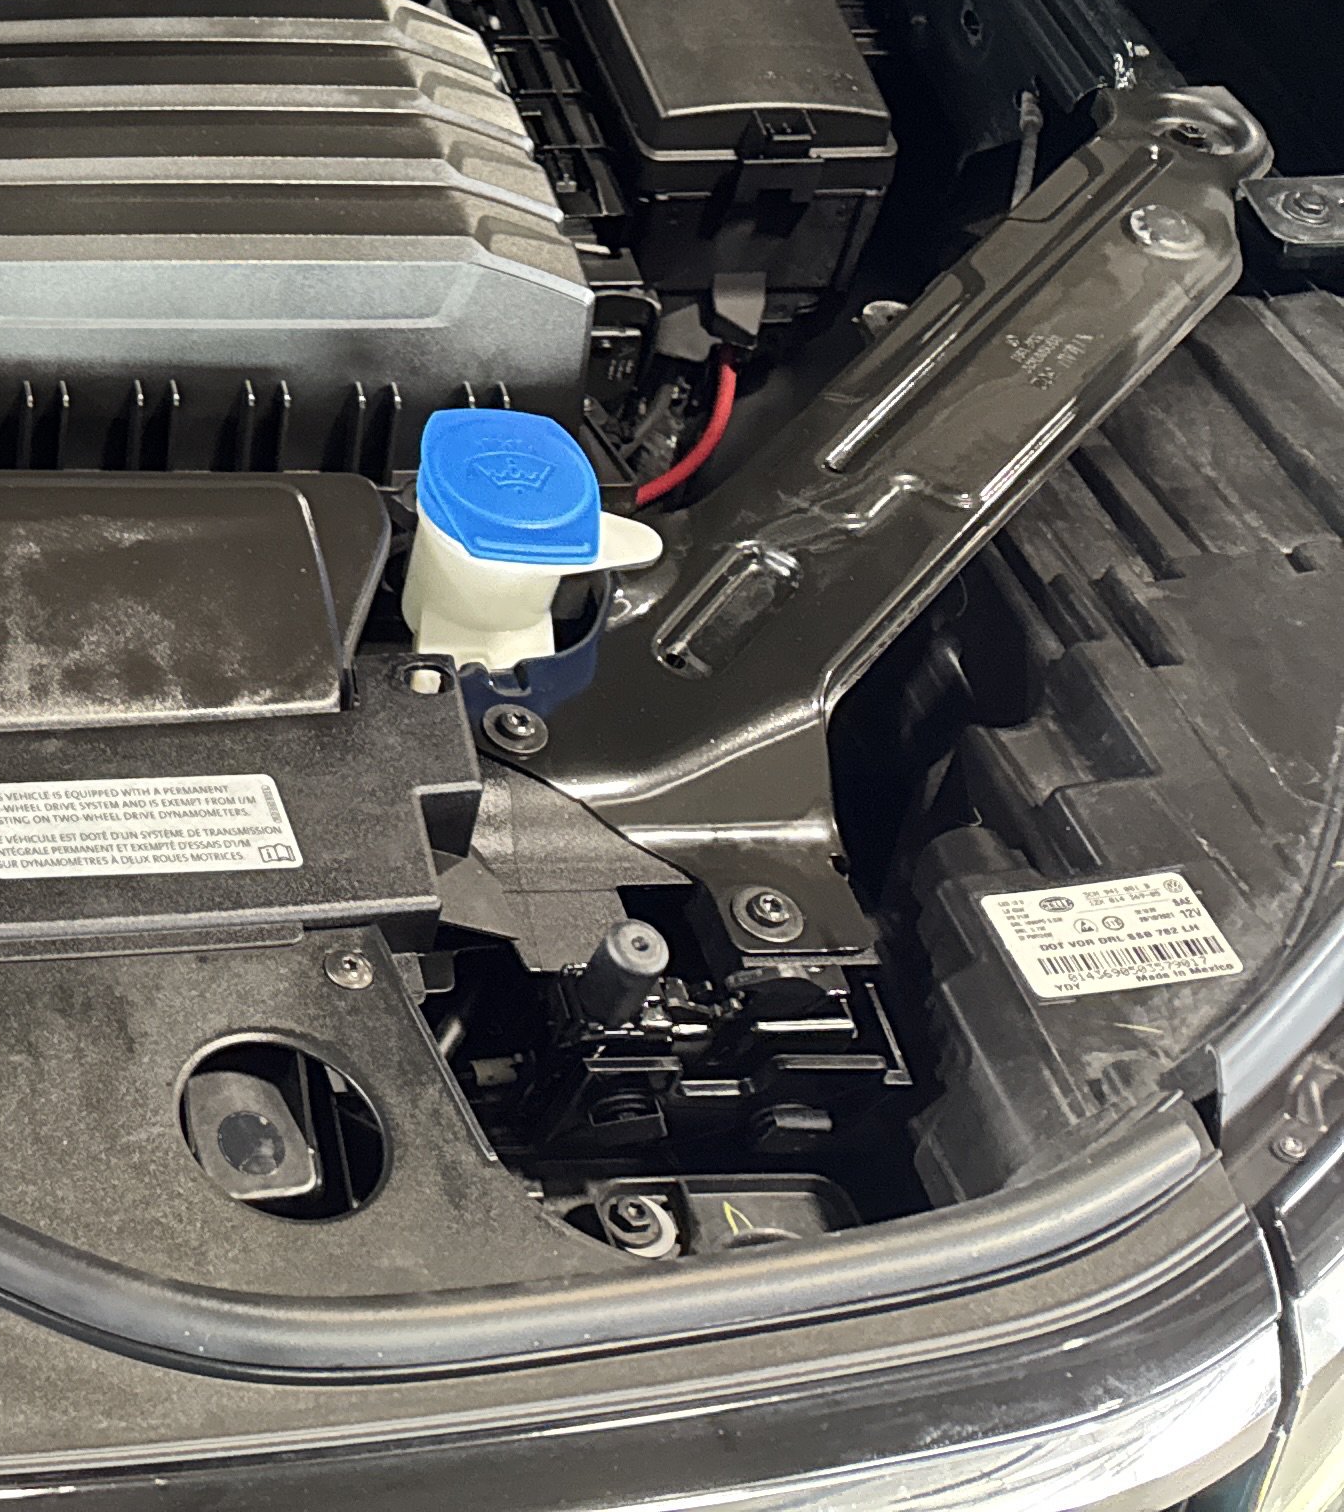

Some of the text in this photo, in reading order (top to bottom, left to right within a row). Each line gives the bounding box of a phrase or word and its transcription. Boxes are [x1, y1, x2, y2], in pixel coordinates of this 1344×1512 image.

[4, 791, 49, 801] VEHICLE
[64, 789, 119, 799] EQUIPPED
[120, 788, 150, 799] WITH
[153, 787, 161, 795] A
[164, 785, 229, 795] PERMANENT
[44, 802, 77, 812] DRIVE
[79, 801, 119, 810] SYSTEM
[122, 800, 146, 810] AND
[149, 799, 159, 807] IS
[162, 797, 202, 807] EXEMPT
[205, 796, 235, 805] FROM
[33, 814, 51, 824] ON
[123, 811, 156, 820] DRIVE
[59, 833, 77, 842] EST
[80, 831, 107, 842] DOTÉ
[187, 828, 202, 838] DE
[203, 826, 283, 837] TRANSMISSION
[51, 844, 115, 855] PERMANENT
[117, 844, 129, 852] ET
[121, 855, 150, 865] DEUX
[152, 852, 189, 863] ROUES
[1180, 908, 1202, 919] 12V
[1040, 942, 1064, 951] DOT
[1136, 972, 1170, 982] Made
[1189, 963, 1234, 974] Mexico
